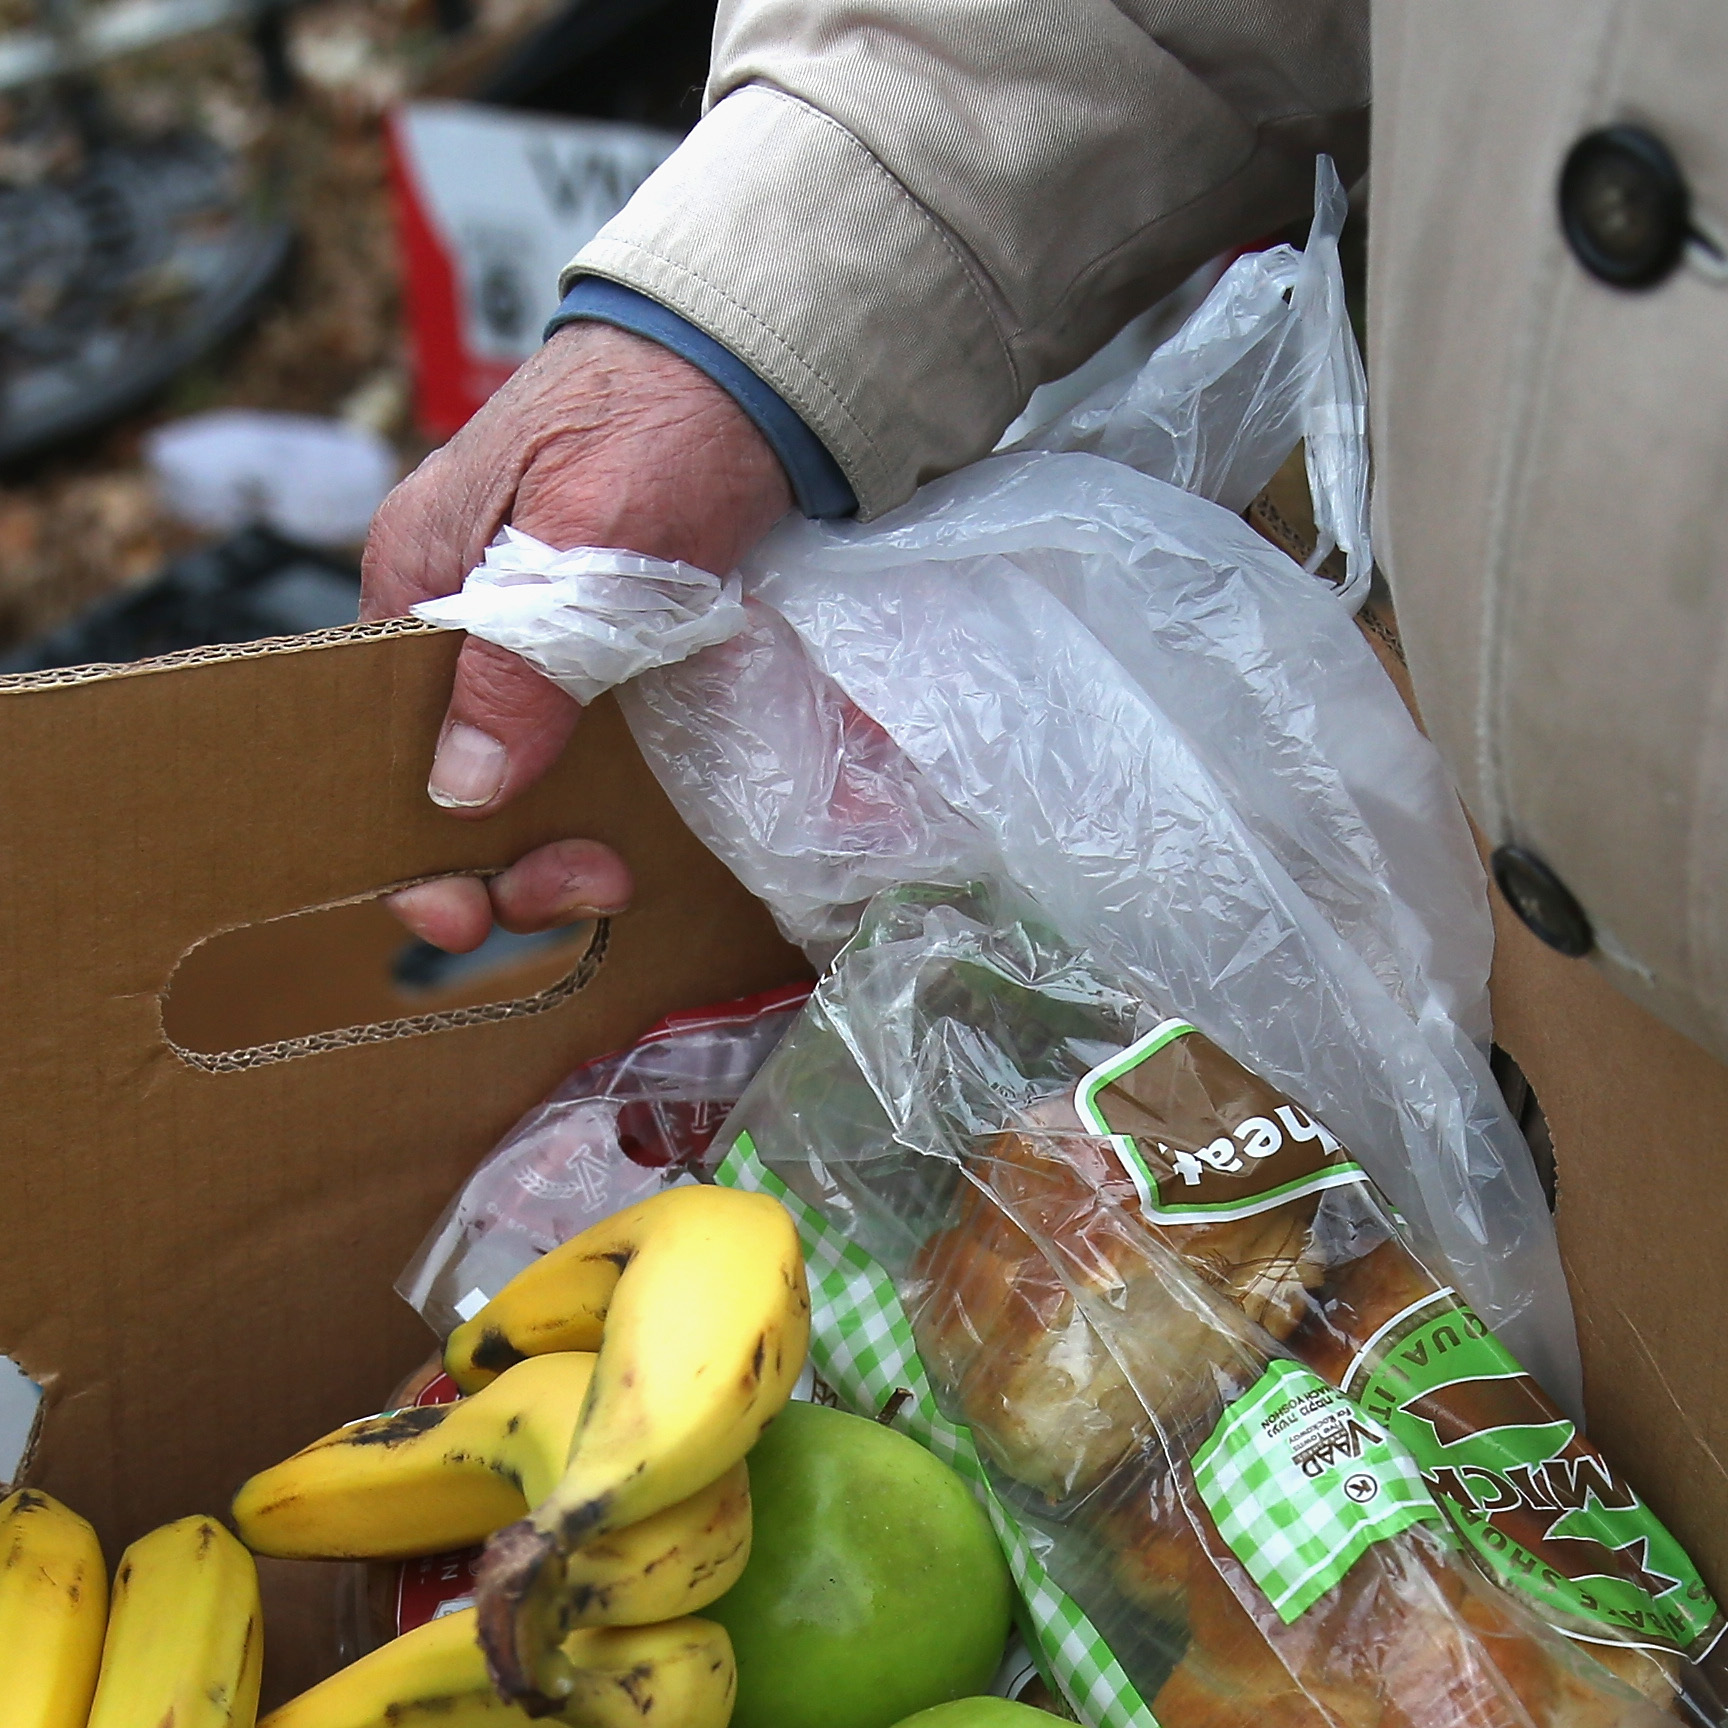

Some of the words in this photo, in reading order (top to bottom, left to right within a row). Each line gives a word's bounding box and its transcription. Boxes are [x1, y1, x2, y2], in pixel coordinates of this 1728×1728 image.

[1157, 1105, 1342, 1187] heat
[1368, 1311, 1489, 1430] QUALIT
[1261, 1396, 1305, 1429] YOSHON
[1301, 1419, 1384, 1478] VAAD
